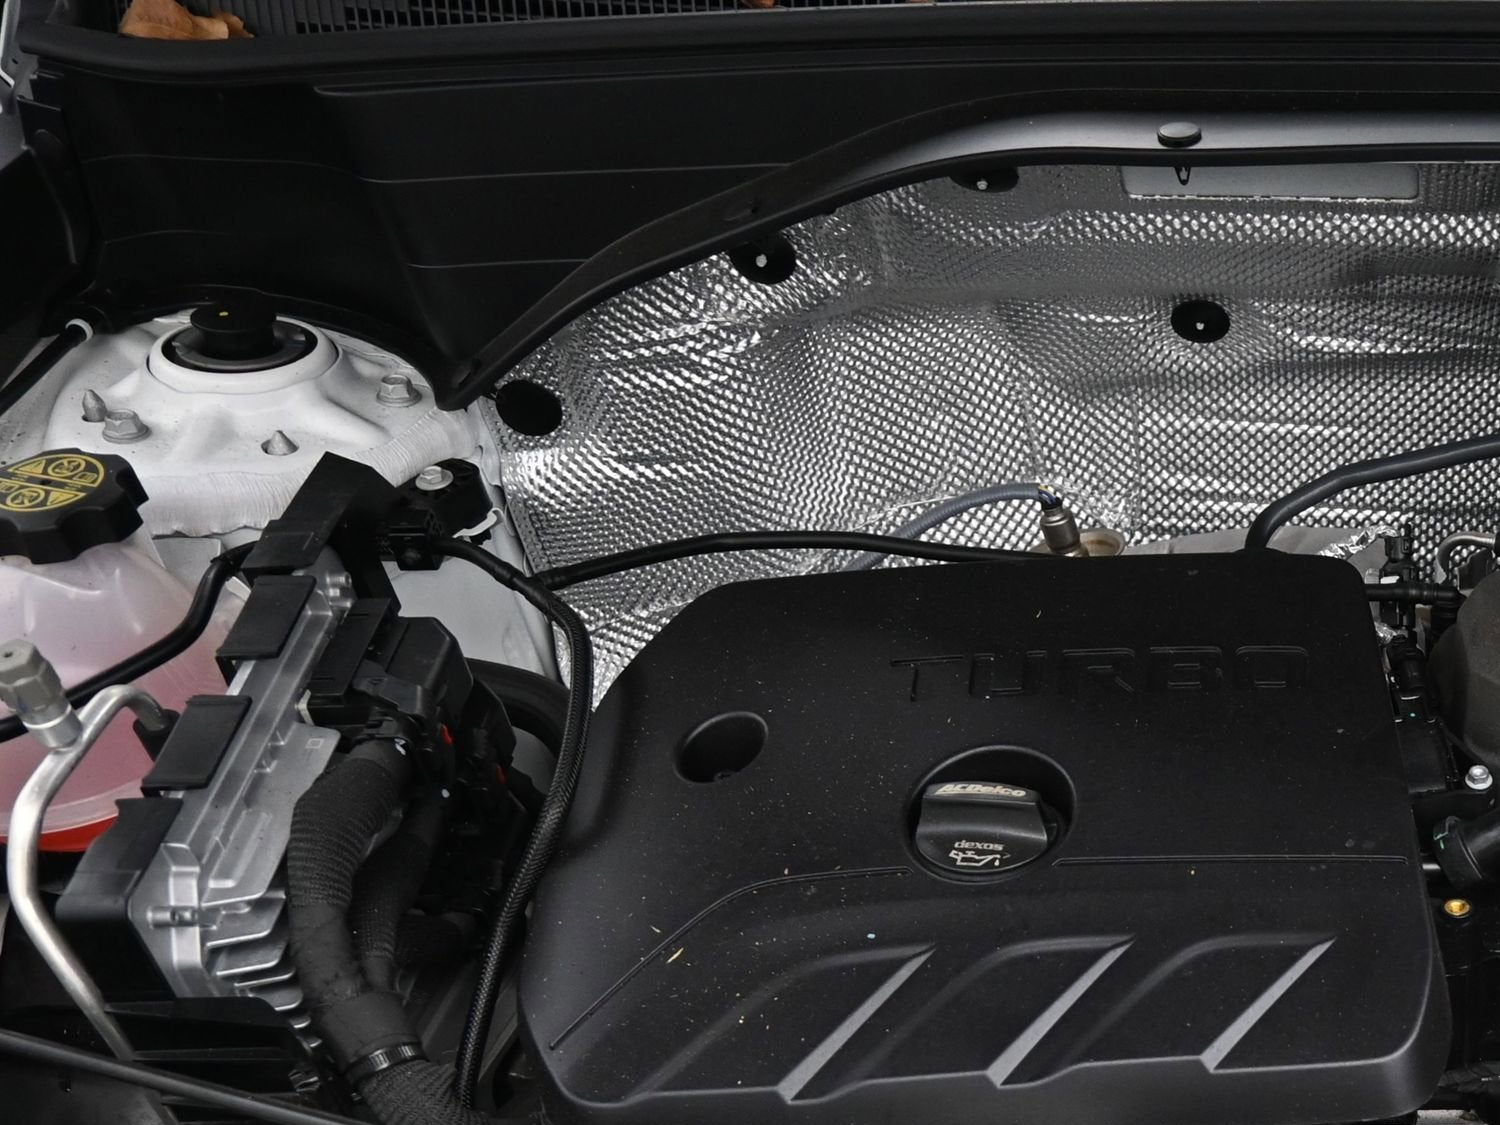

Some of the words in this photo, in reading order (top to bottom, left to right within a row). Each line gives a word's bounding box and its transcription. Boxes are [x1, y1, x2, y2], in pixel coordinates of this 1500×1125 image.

[890, 645, 1309, 702] TURBO
[934, 784, 1027, 797] ACDelco
[954, 840, 1005, 851] dexos
